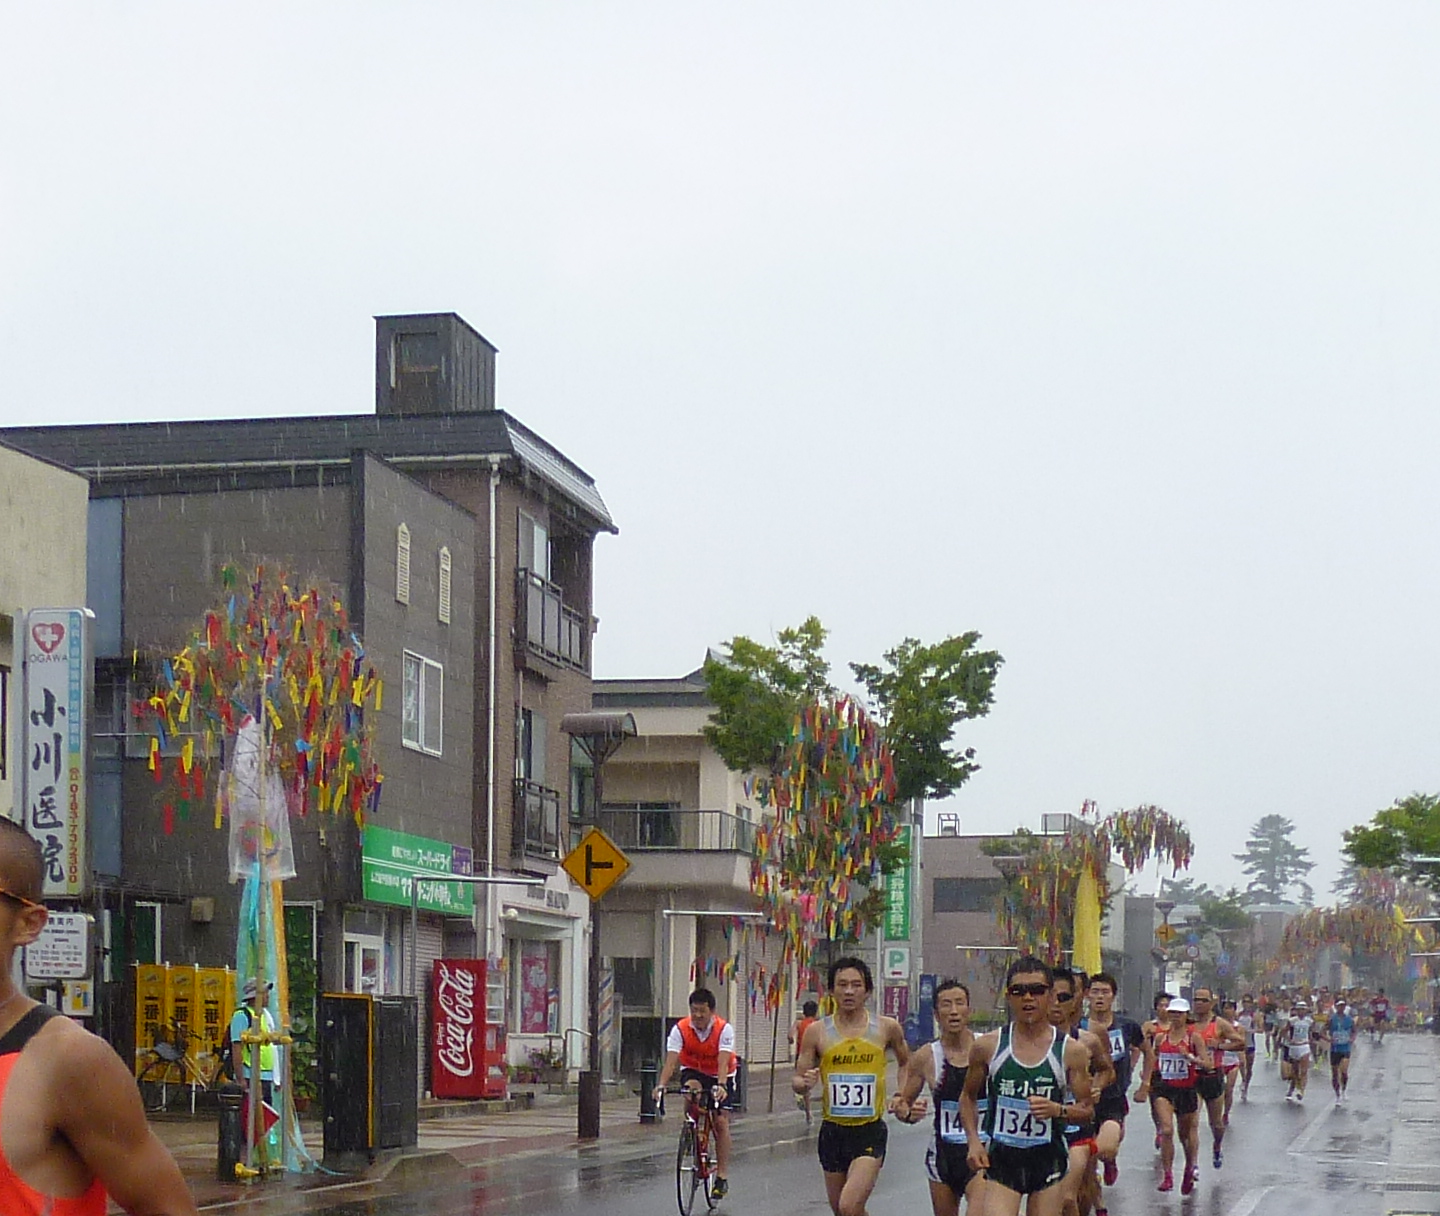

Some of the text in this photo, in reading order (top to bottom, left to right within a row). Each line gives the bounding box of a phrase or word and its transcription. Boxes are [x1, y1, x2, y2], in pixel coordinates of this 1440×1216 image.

[30, 654, 68, 663] OGAWA
[30, 687, 65, 883] 小川医院
[889, 950, 905, 968] P
[439, 961, 474, 1077] Coca-Cola
[1161, 1059, 1185, 1073] 1712
[833, 1084, 872, 1106] 1331
[1000, 1108, 1047, 1137] 1345
